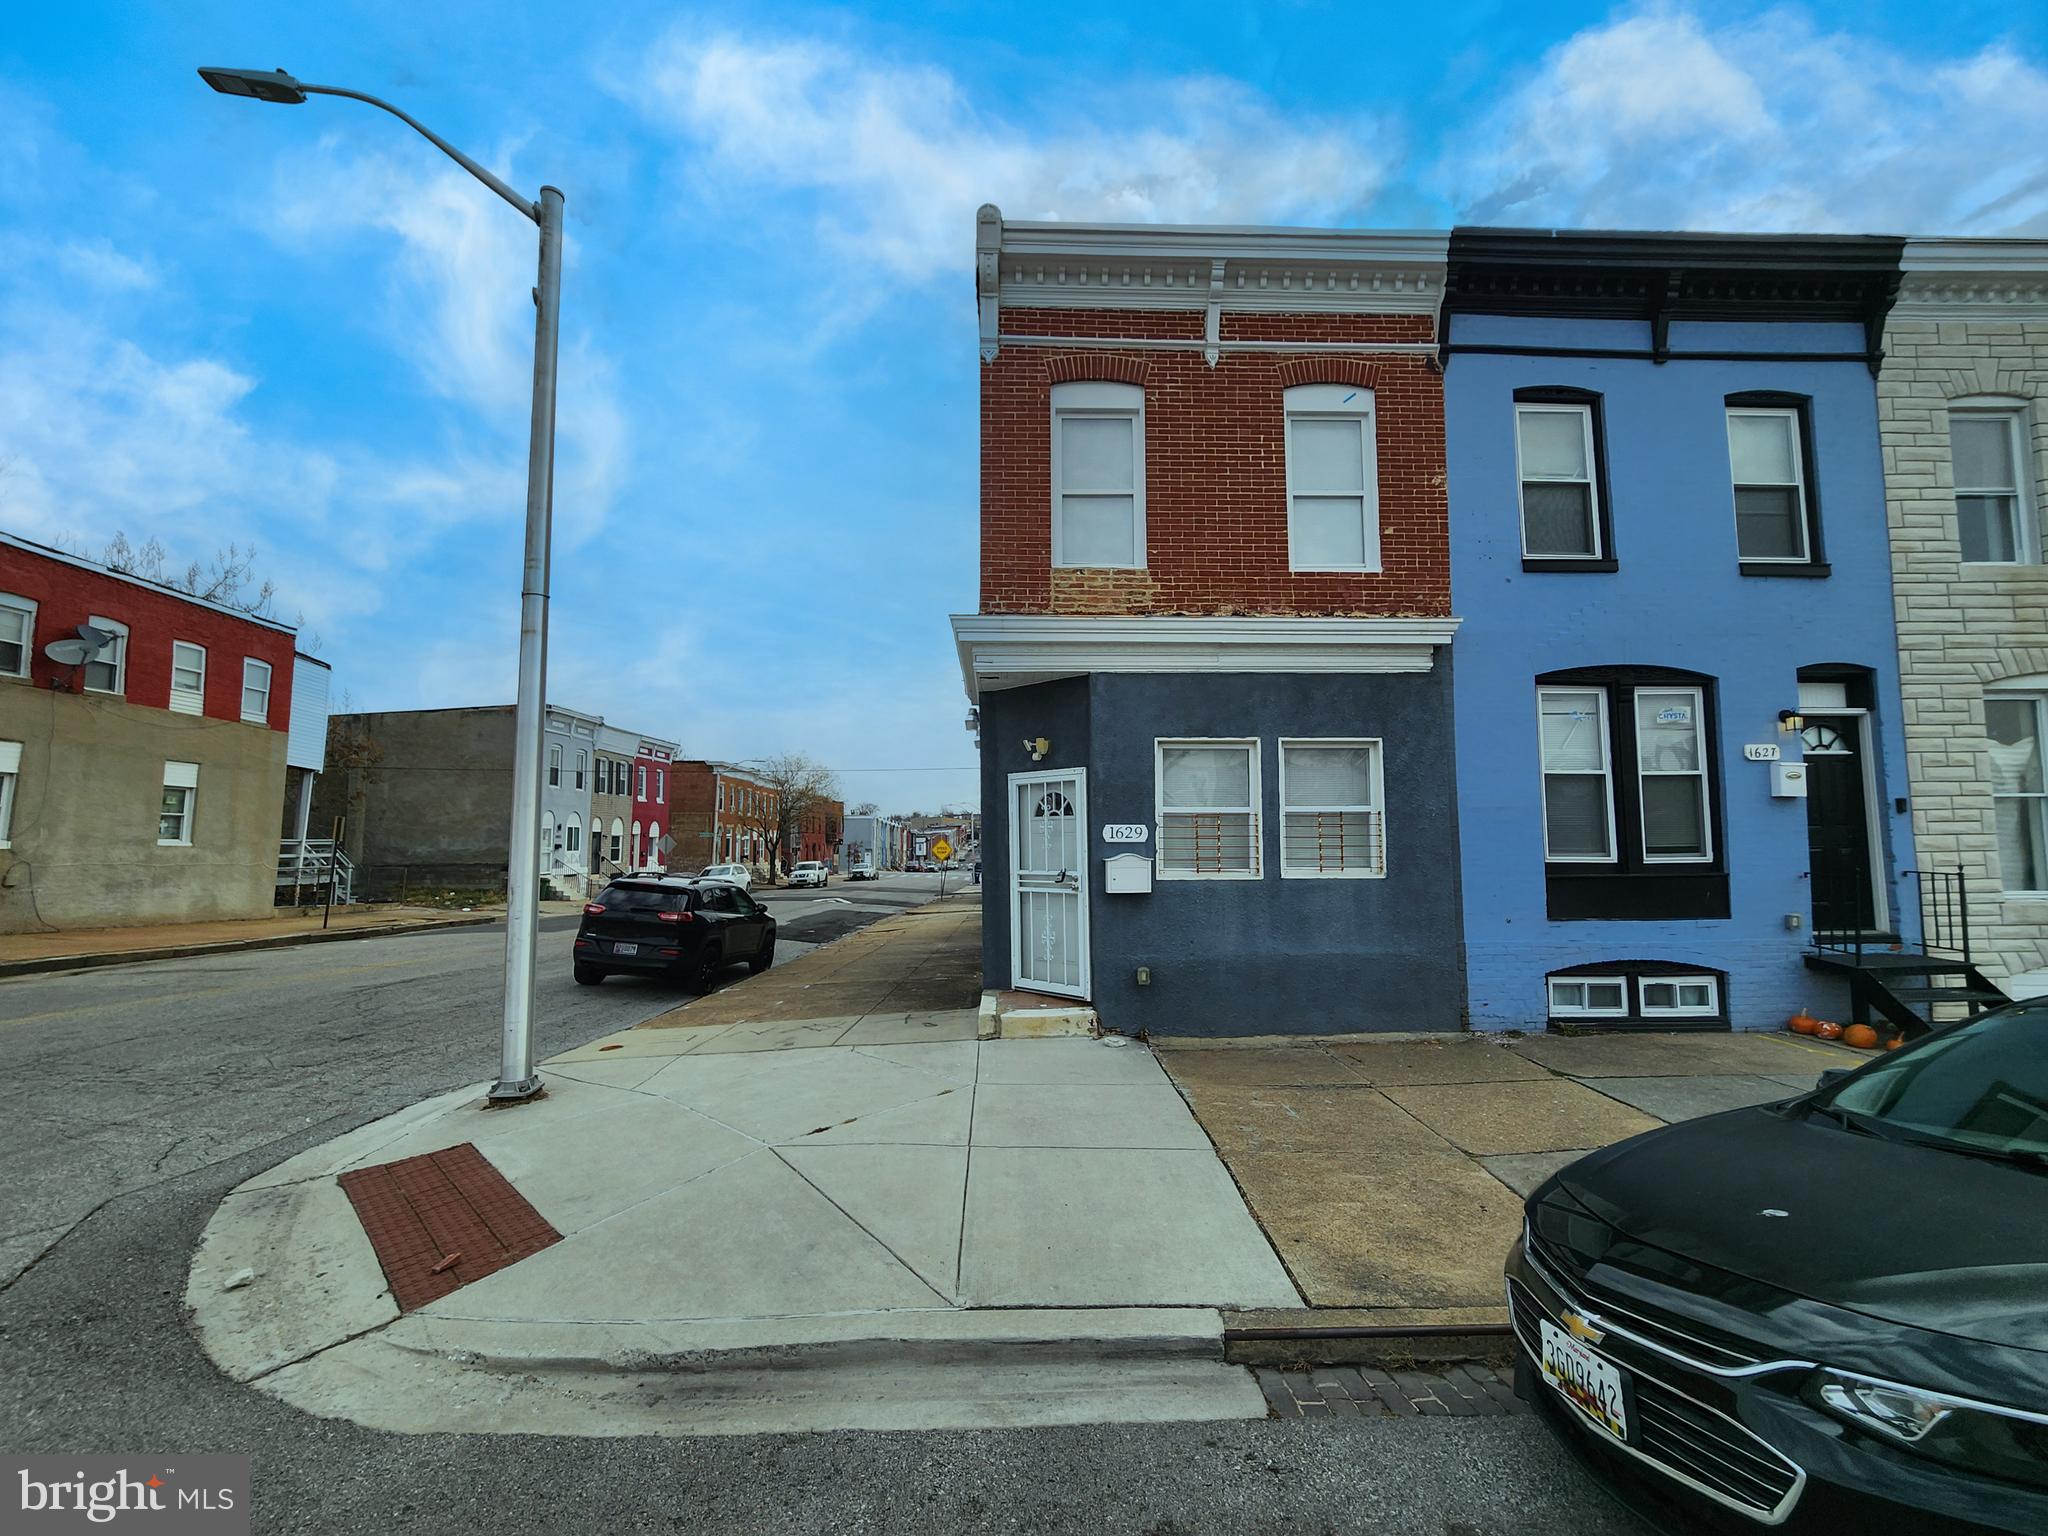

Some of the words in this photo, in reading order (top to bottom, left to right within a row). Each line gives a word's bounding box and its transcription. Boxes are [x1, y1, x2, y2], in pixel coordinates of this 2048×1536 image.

[1748, 747, 1777, 758] 1627
[1109, 826, 1143, 839] 1629
[1546, 1339, 1620, 1420] 3GD9642
